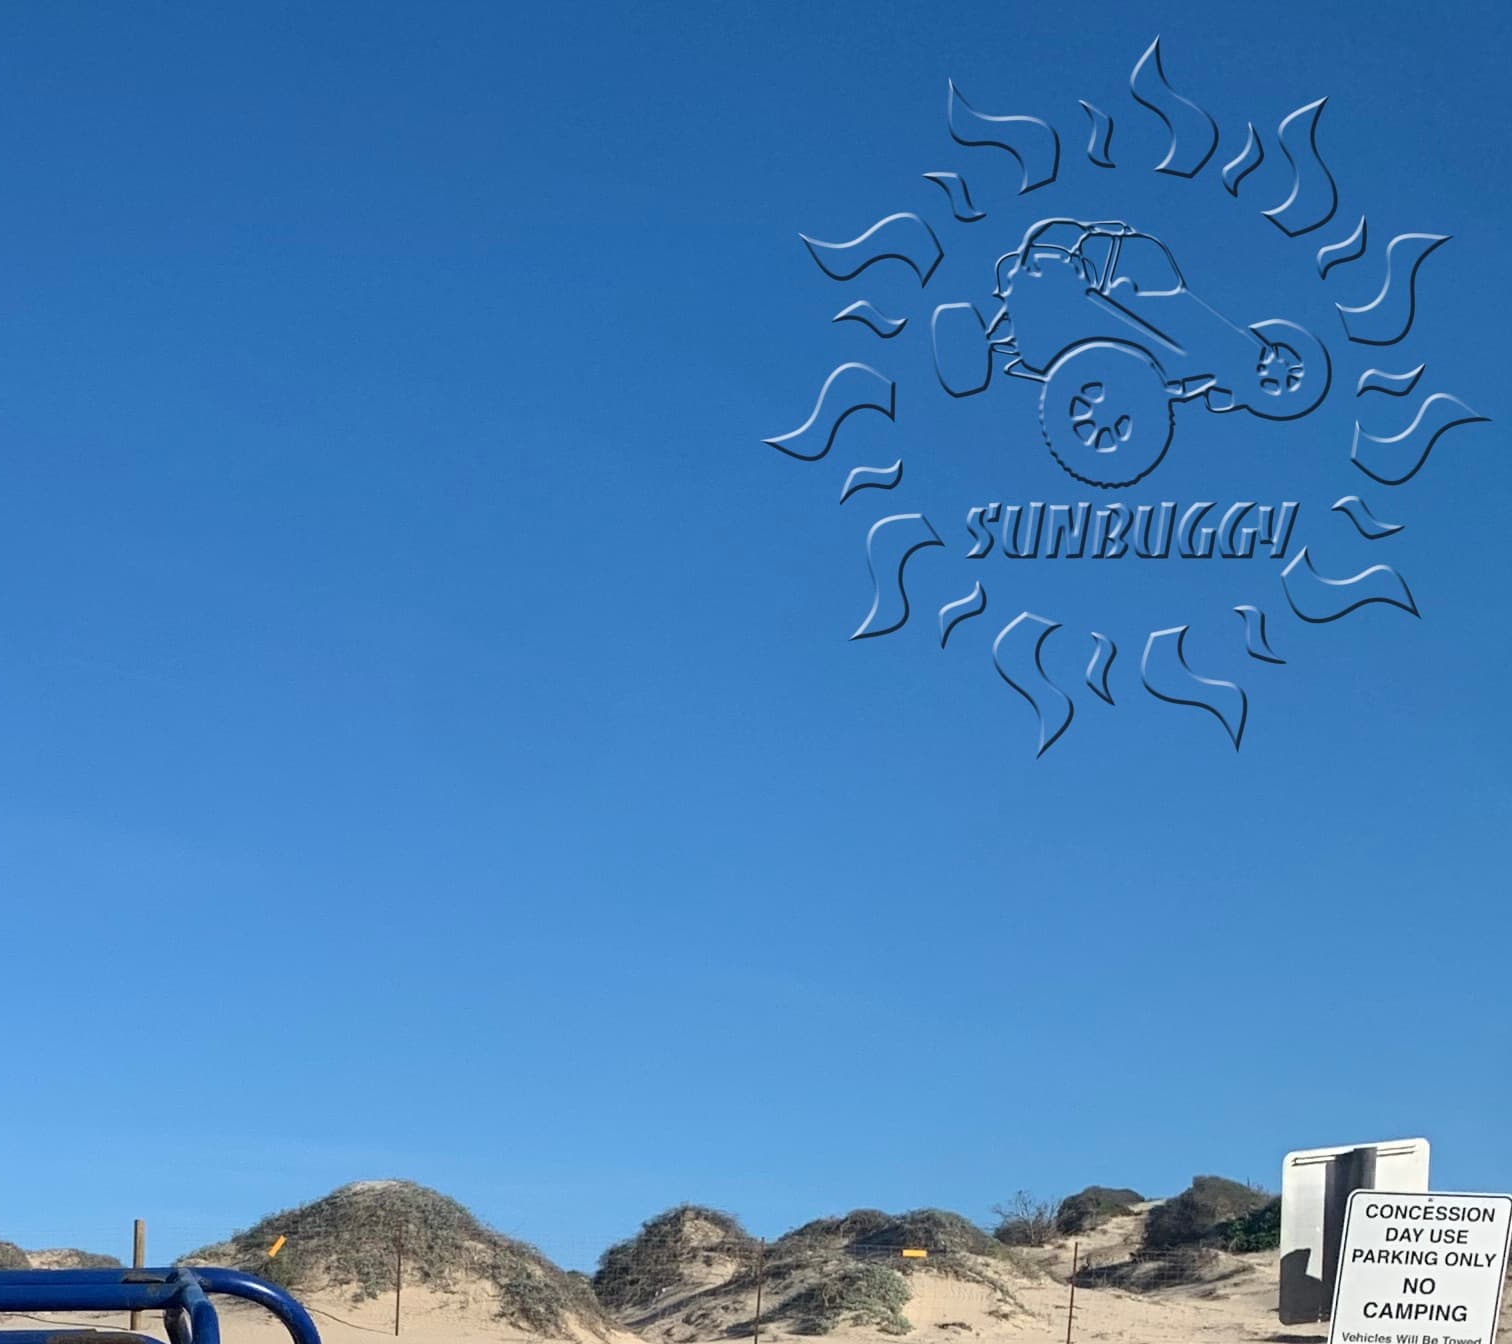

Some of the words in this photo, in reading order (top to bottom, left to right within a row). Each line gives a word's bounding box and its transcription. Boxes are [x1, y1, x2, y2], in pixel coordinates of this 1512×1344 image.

[1365, 1203, 1496, 1223] CONCESSION
[1385, 1227, 1424, 1243] DAY
[1429, 1229, 1469, 1244] USE
[1351, 1248, 1438, 1266] PARKING
[1444, 1252, 1497, 1268] ONLY
[1402, 1277, 1436, 1295] NO
[1362, 1302, 1468, 1322] CAMPING
[1342, 1331, 1392, 1344] Vehicles
[1396, 1334, 1418, 1344] Will
